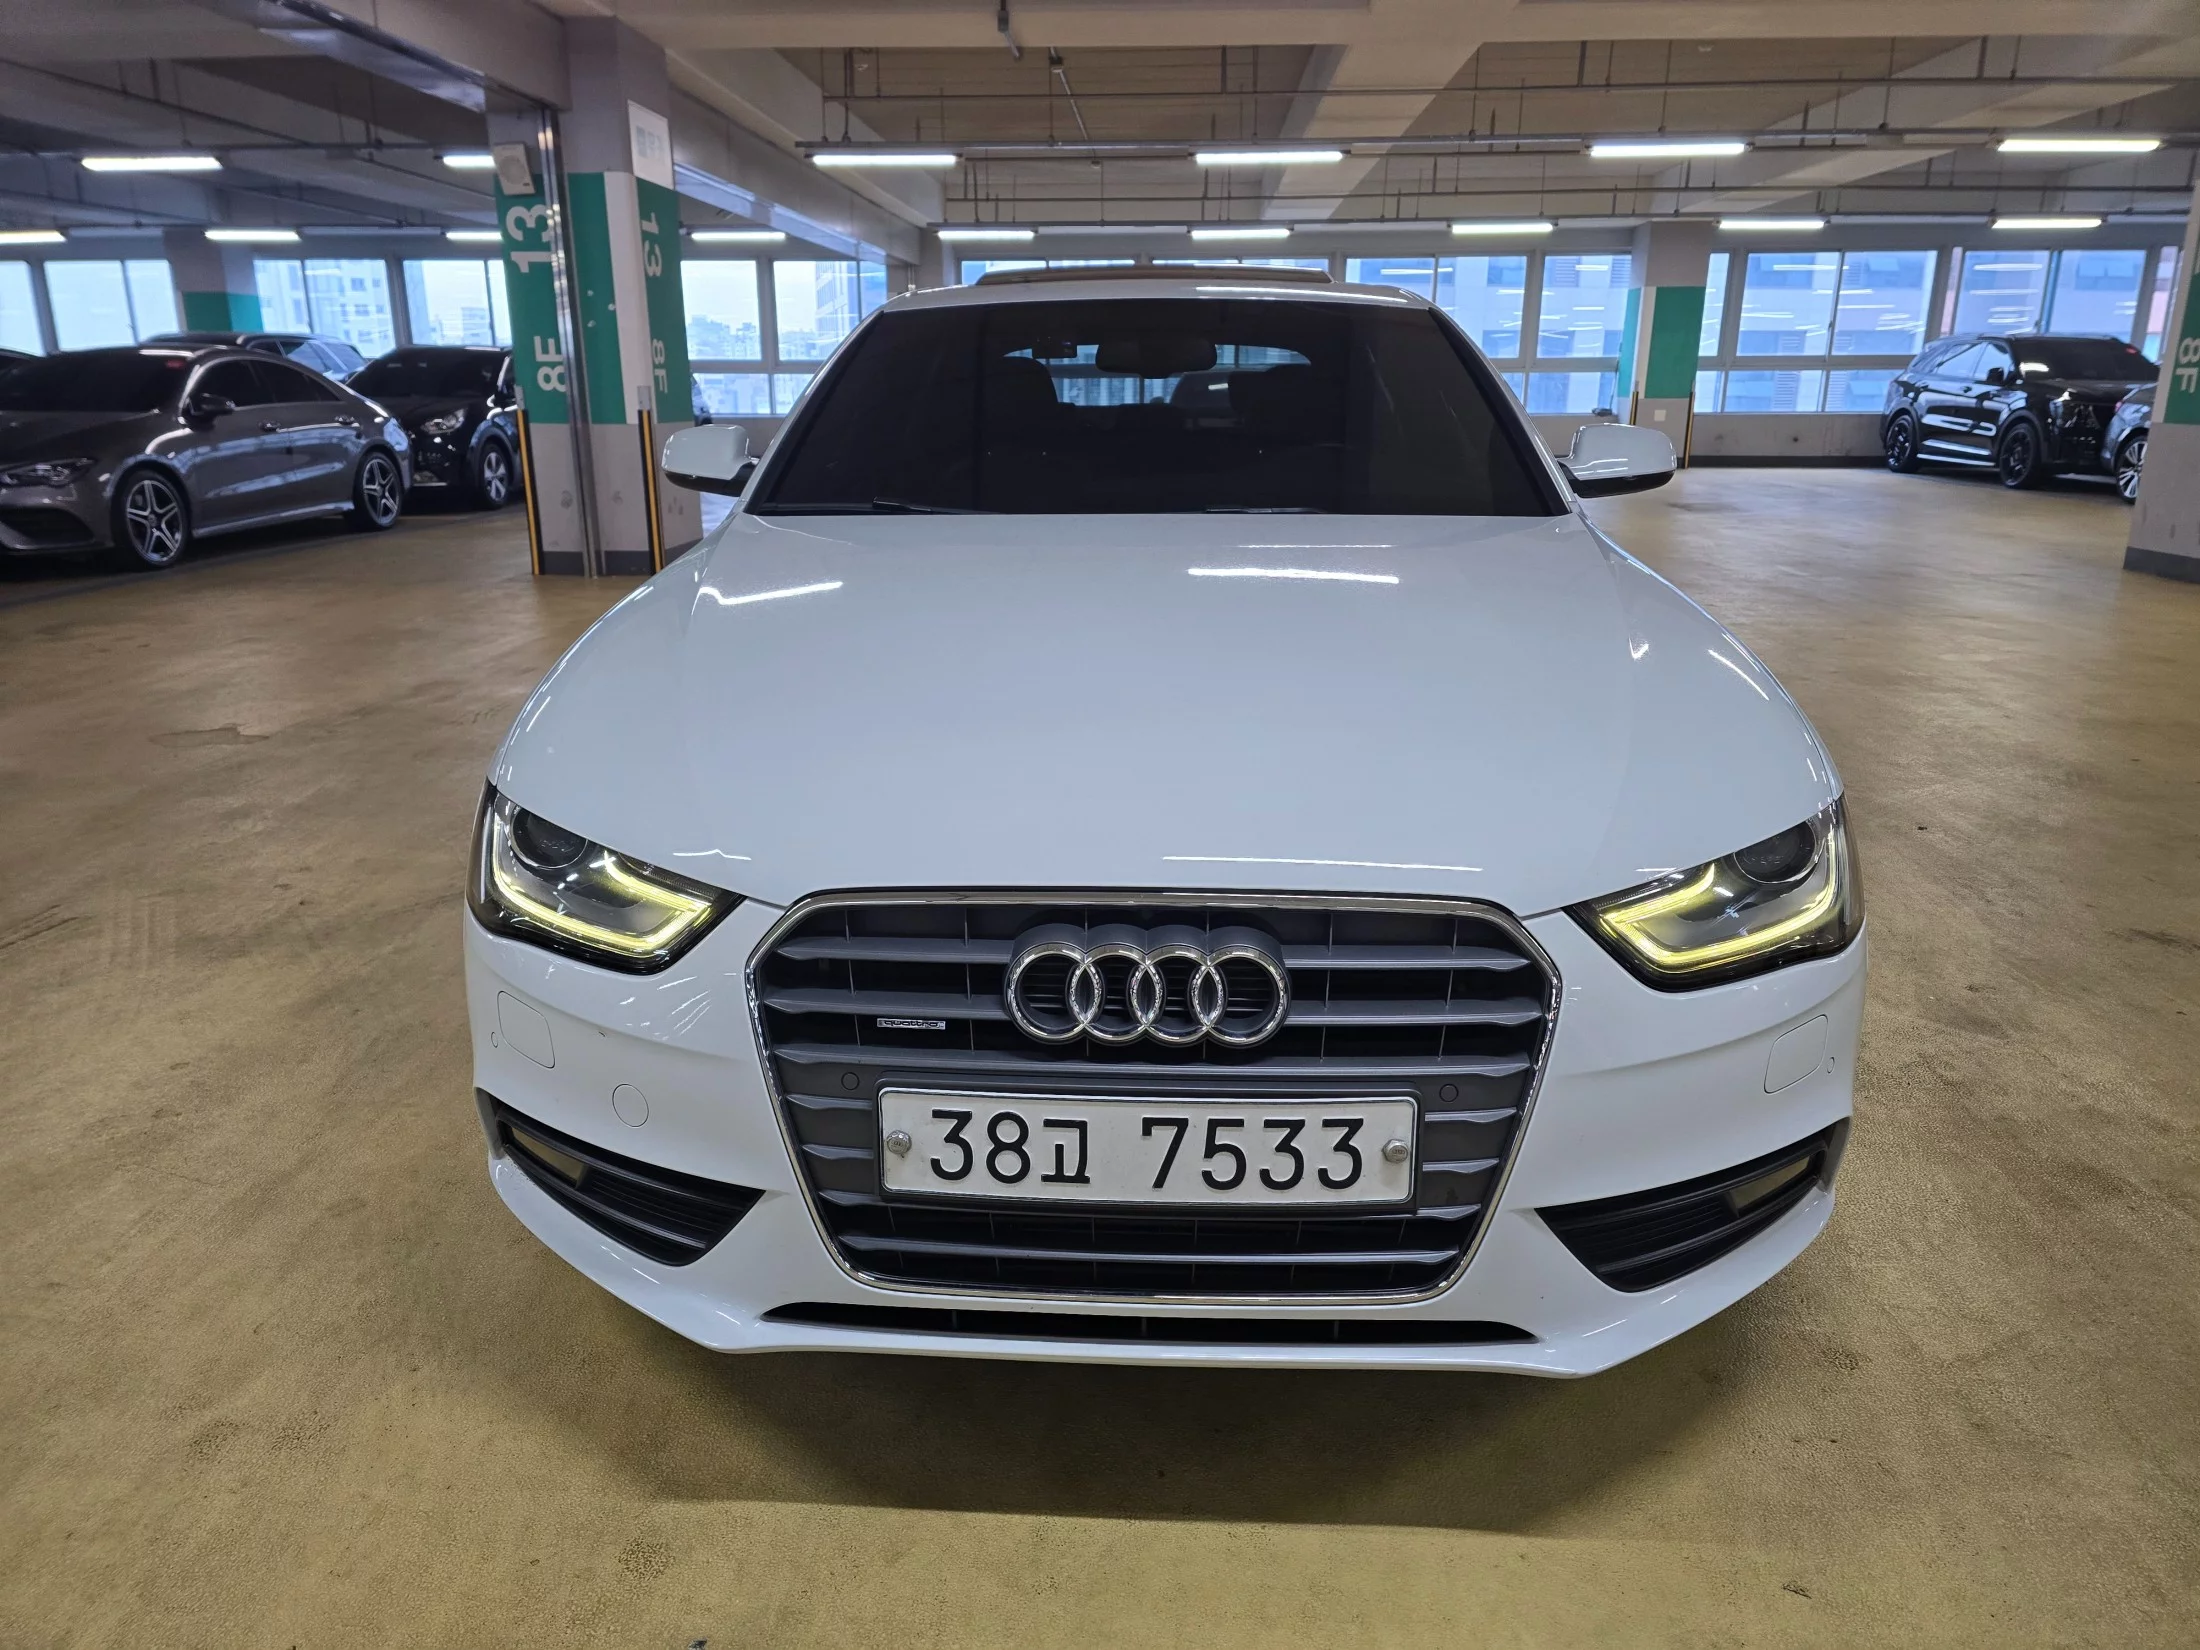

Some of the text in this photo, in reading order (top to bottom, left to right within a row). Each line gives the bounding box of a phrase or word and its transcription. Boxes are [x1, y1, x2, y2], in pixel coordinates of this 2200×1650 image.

[506, 205, 566, 392] 8F 13
[641, 212, 668, 394] 13 8F
[2175, 337, 2200, 393] 8F
[881, 1019, 941, 1029] quattro
[930, 1109, 1365, 1190] 38고 7533
